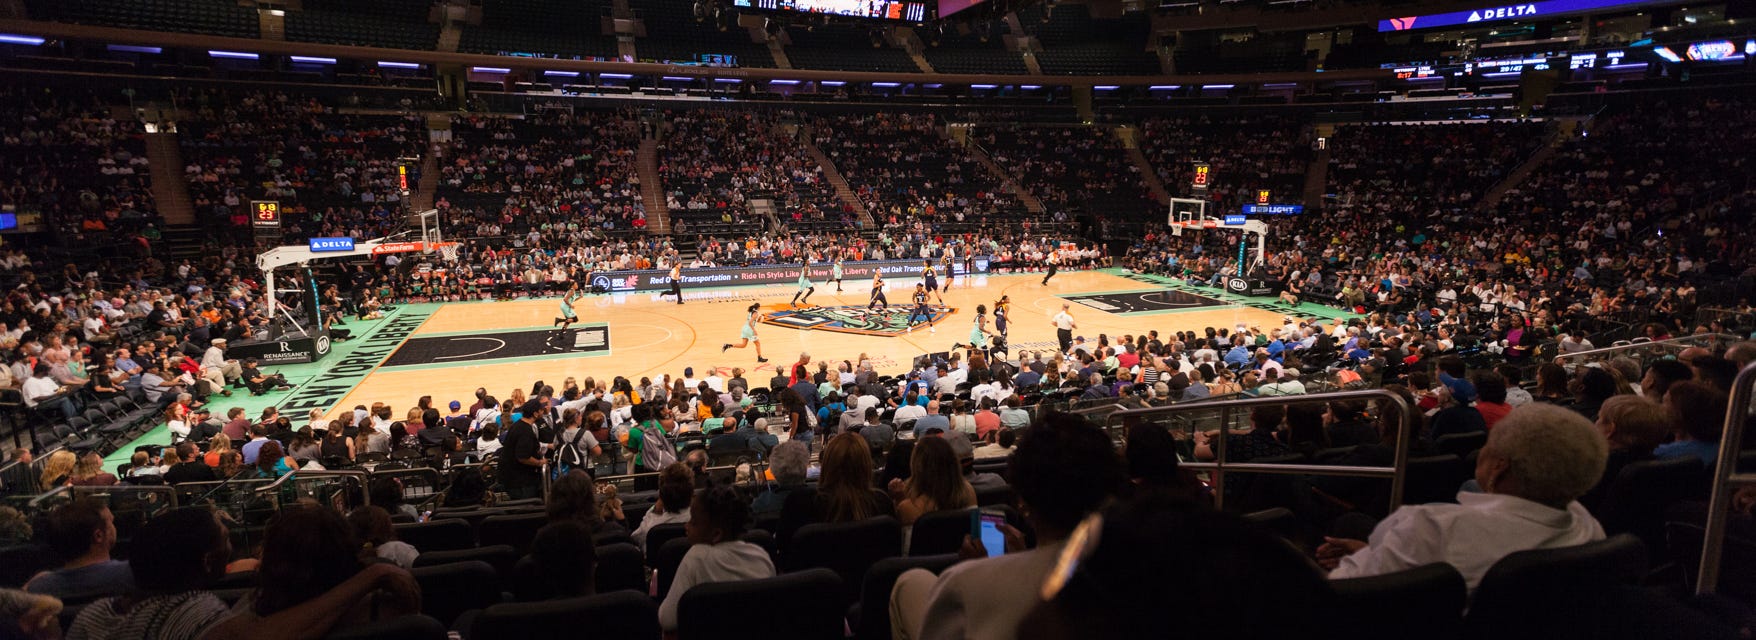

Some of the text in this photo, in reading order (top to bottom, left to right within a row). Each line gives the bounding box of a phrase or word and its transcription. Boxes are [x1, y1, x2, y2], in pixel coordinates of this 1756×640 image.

[1484, 4, 1536, 20] DELTA
[1195, 172, 1206, 184] 23
[259, 210, 275, 220] 23
[1269, 206, 1295, 214] LIGHT
[649, 276, 664, 285] Red
[681, 273, 731, 284] Transportation
[741, 272, 757, 280] Ride
[766, 271, 784, 280] Style
[785, 270, 800, 278] Like
[845, 267, 868, 275] Liberty
[1231, 280, 1245, 289] KIA
[280, 341, 292, 352] R
[278, 313, 431, 422] NEW YORK LIBERTY
